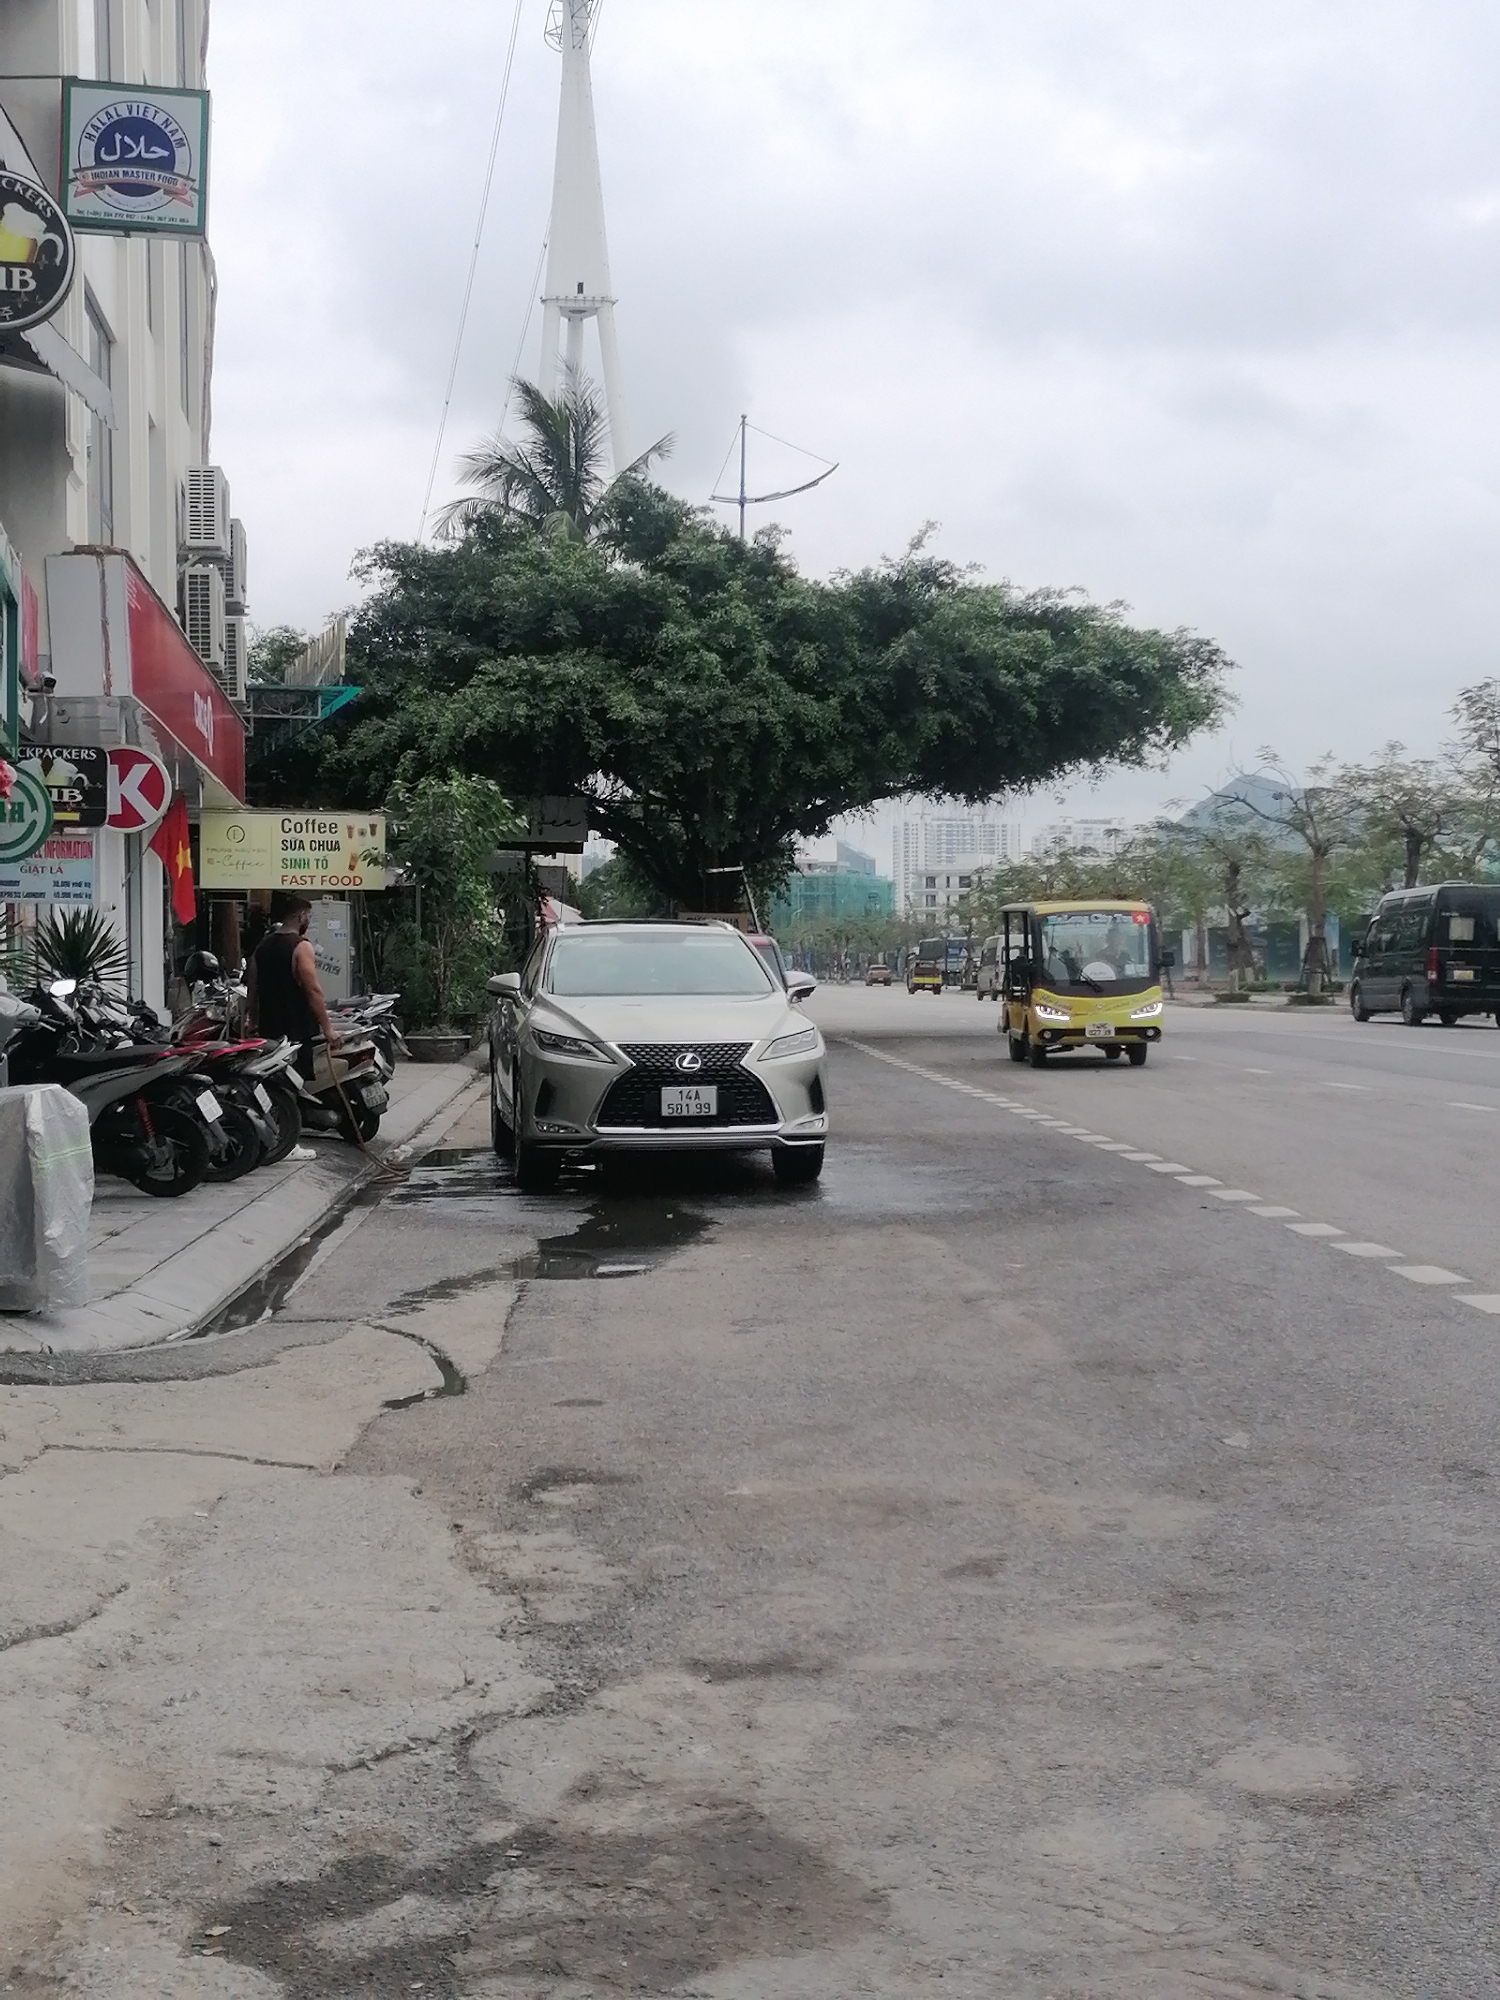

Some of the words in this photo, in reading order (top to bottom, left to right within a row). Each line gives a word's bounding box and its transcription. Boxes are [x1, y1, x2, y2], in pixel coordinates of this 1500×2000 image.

[84, 106, 122, 142] HALAL
[126, 104, 159, 120] VIET
[161, 118, 186, 149] NAM
[100, 132, 170, 162] حلال
[91, 170, 120, 181] INDIAN
[122, 169, 156, 182] MASTER
[157, 176, 179, 186] FOOD
[109, 763, 158, 823] K
[281, 817, 338, 835] Coffee
[309, 839, 341, 852] CHUA
[281, 857, 310, 870] SINH
[314, 853, 329, 870] TỐ
[281, 874, 316, 886] FAST
[320, 875, 363, 887] FOOD
[678, 1089, 701, 1102] 14A
